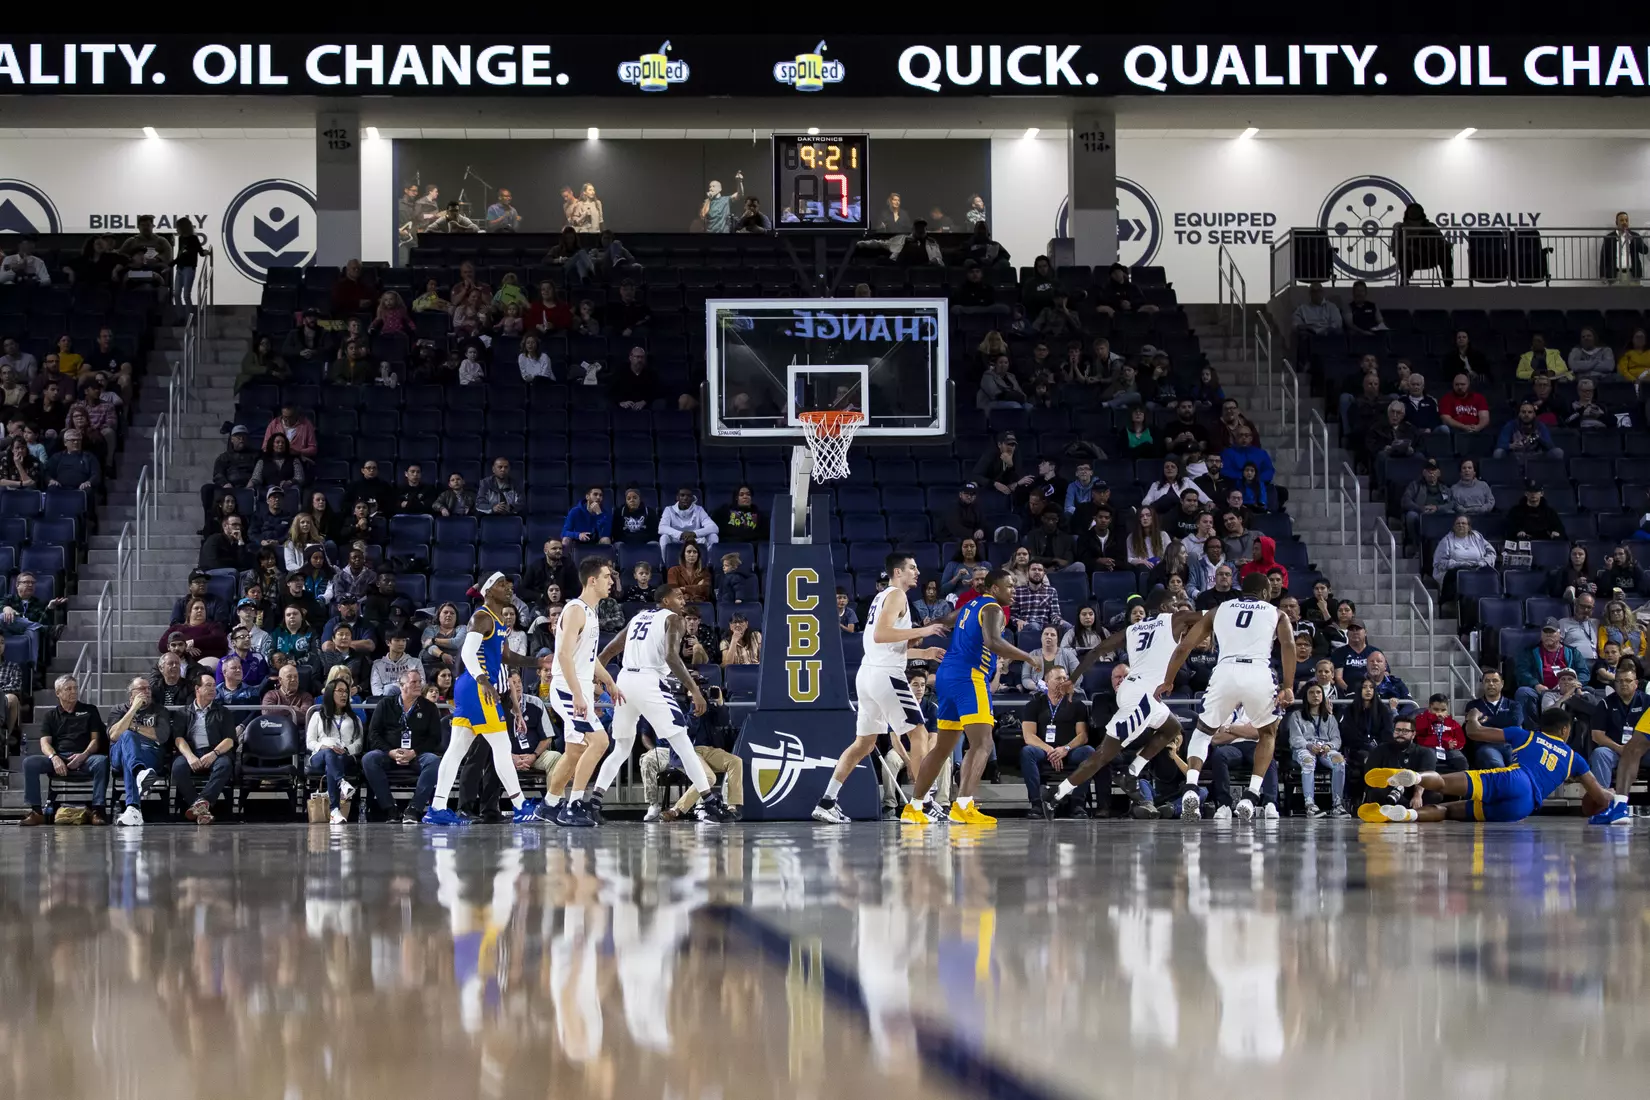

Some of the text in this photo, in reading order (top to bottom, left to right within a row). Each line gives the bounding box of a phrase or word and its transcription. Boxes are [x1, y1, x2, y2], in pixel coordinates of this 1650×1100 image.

[193, 44, 288, 85] OIL
[306, 44, 570, 86] CHANGE.
[898, 45, 1650, 93] QUICK. QUALITY. OIL CHA
[328, 129, 347, 139] 112
[1084, 131, 1105, 141] 113
[328, 140, 346, 150] 113
[1084, 142, 1104, 152] 114
[800, 145, 857, 171] 9:21
[824, 174, 848, 218] 7
[1174, 212, 1277, 227] EQUIPPED
[1435, 212, 1542, 227] GLOBALLY
[1174, 230, 1274, 245] TO SERVE
[1230, 602, 1267, 611] ACQUAAH
[1235, 610, 1254, 629] 0
[629, 621, 652, 641] 35
[785, 568, 823, 703] CBU
[1135, 630, 1156, 652] 31
[1539, 748, 1559, 772] 10
